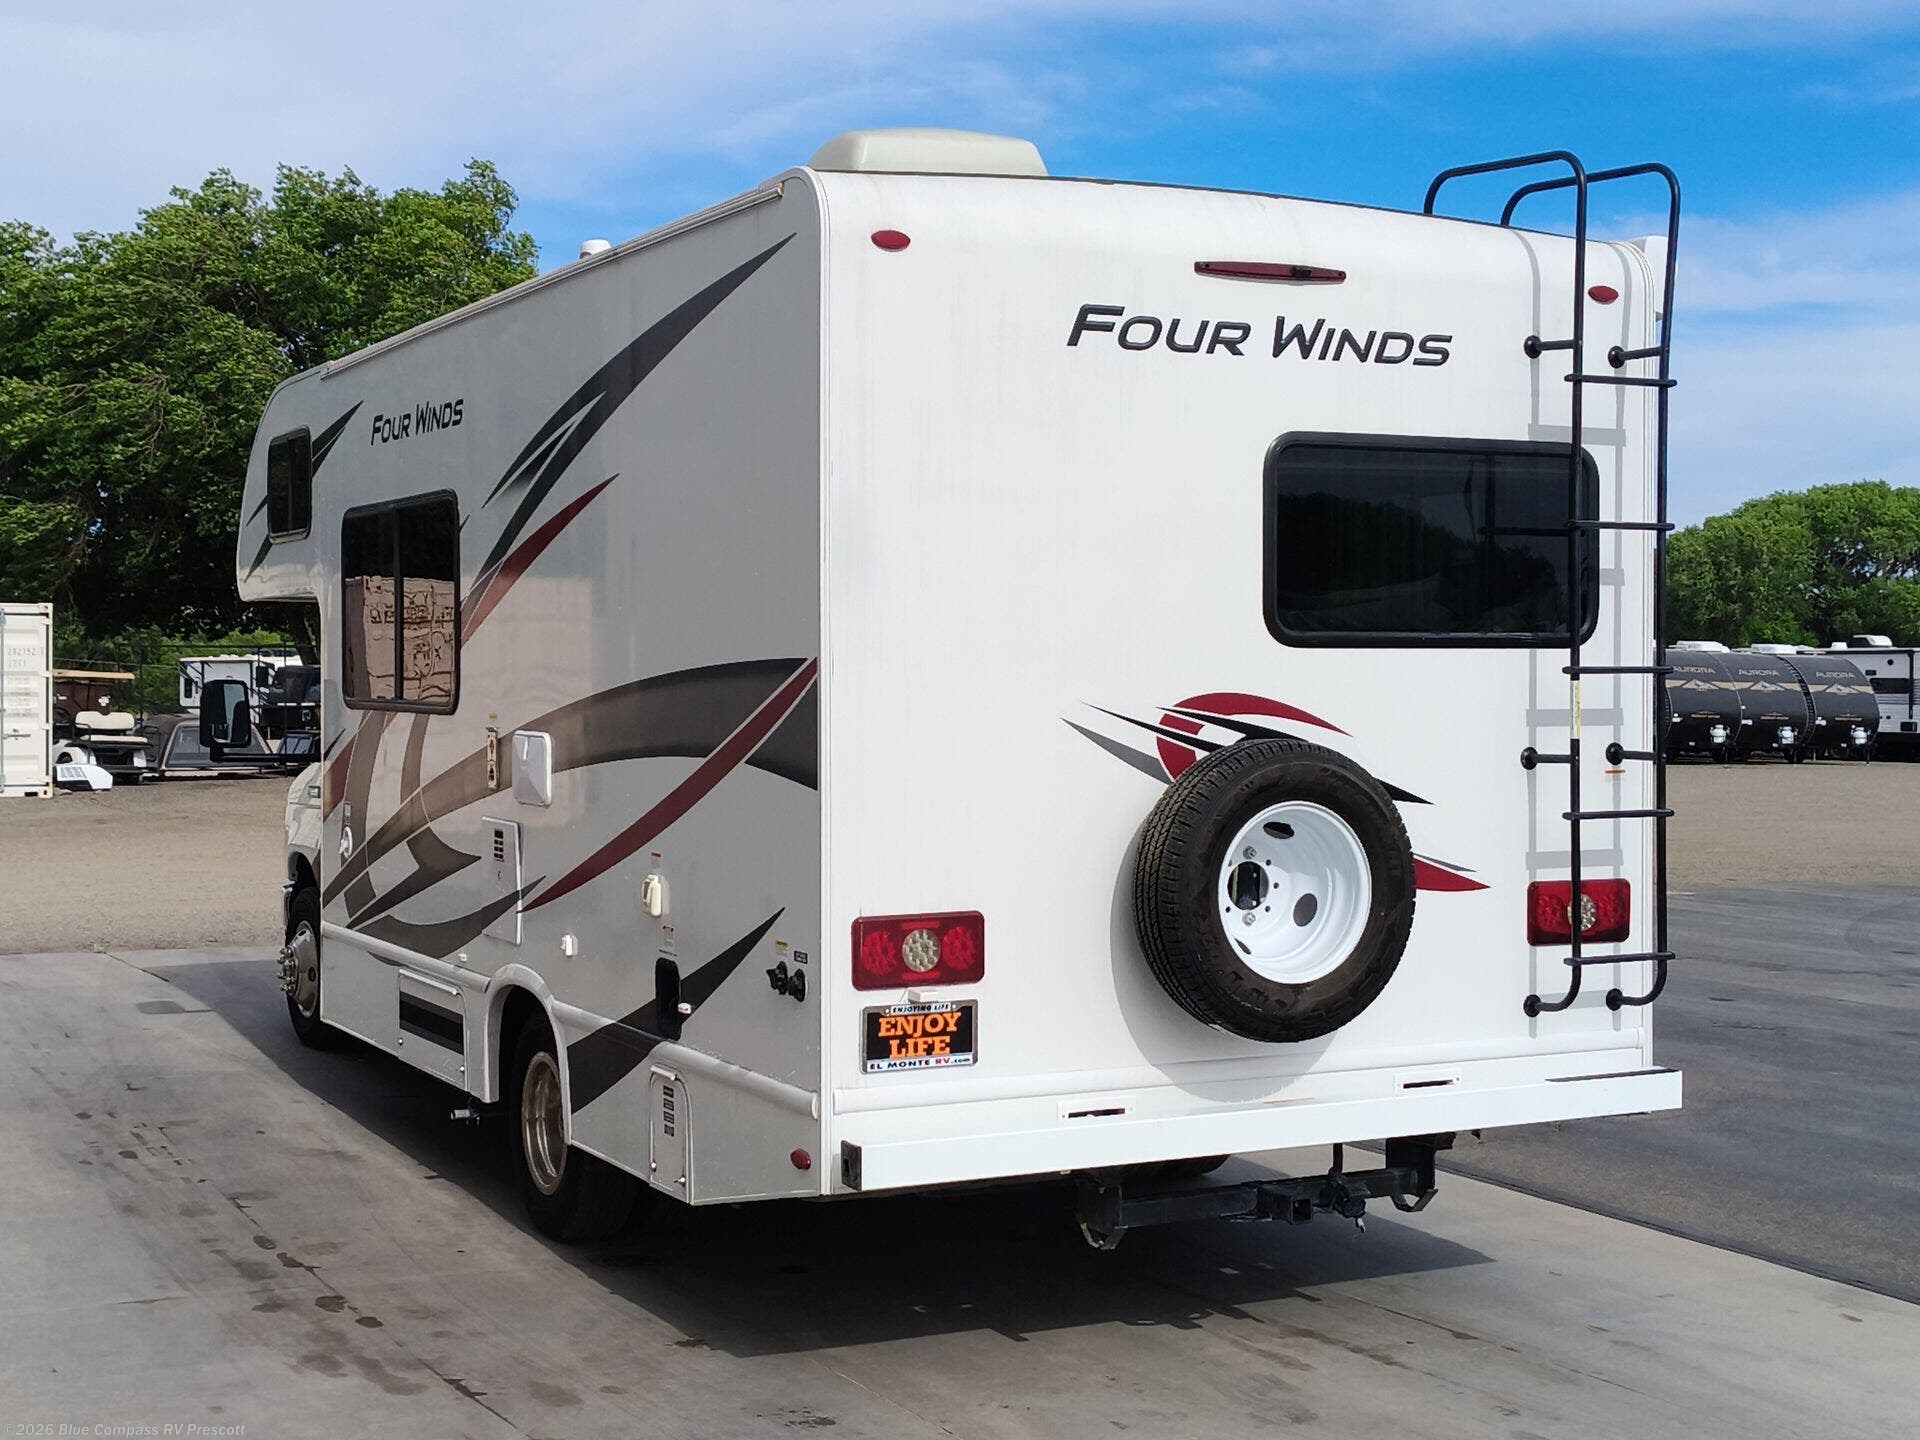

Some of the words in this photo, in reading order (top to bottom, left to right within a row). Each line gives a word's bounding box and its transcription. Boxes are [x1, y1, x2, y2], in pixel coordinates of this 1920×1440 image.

[1067, 303, 1252, 356] FOUR
[1272, 315, 1453, 367] WINDS
[1738, 668, 1780, 677] AURORA
[892, 1005, 932, 1013] ENJOYING
[878, 1011, 962, 1038] ENJOY
[889, 1035, 951, 1060] LIFE
[887, 1060, 931, 1068] MONTE
